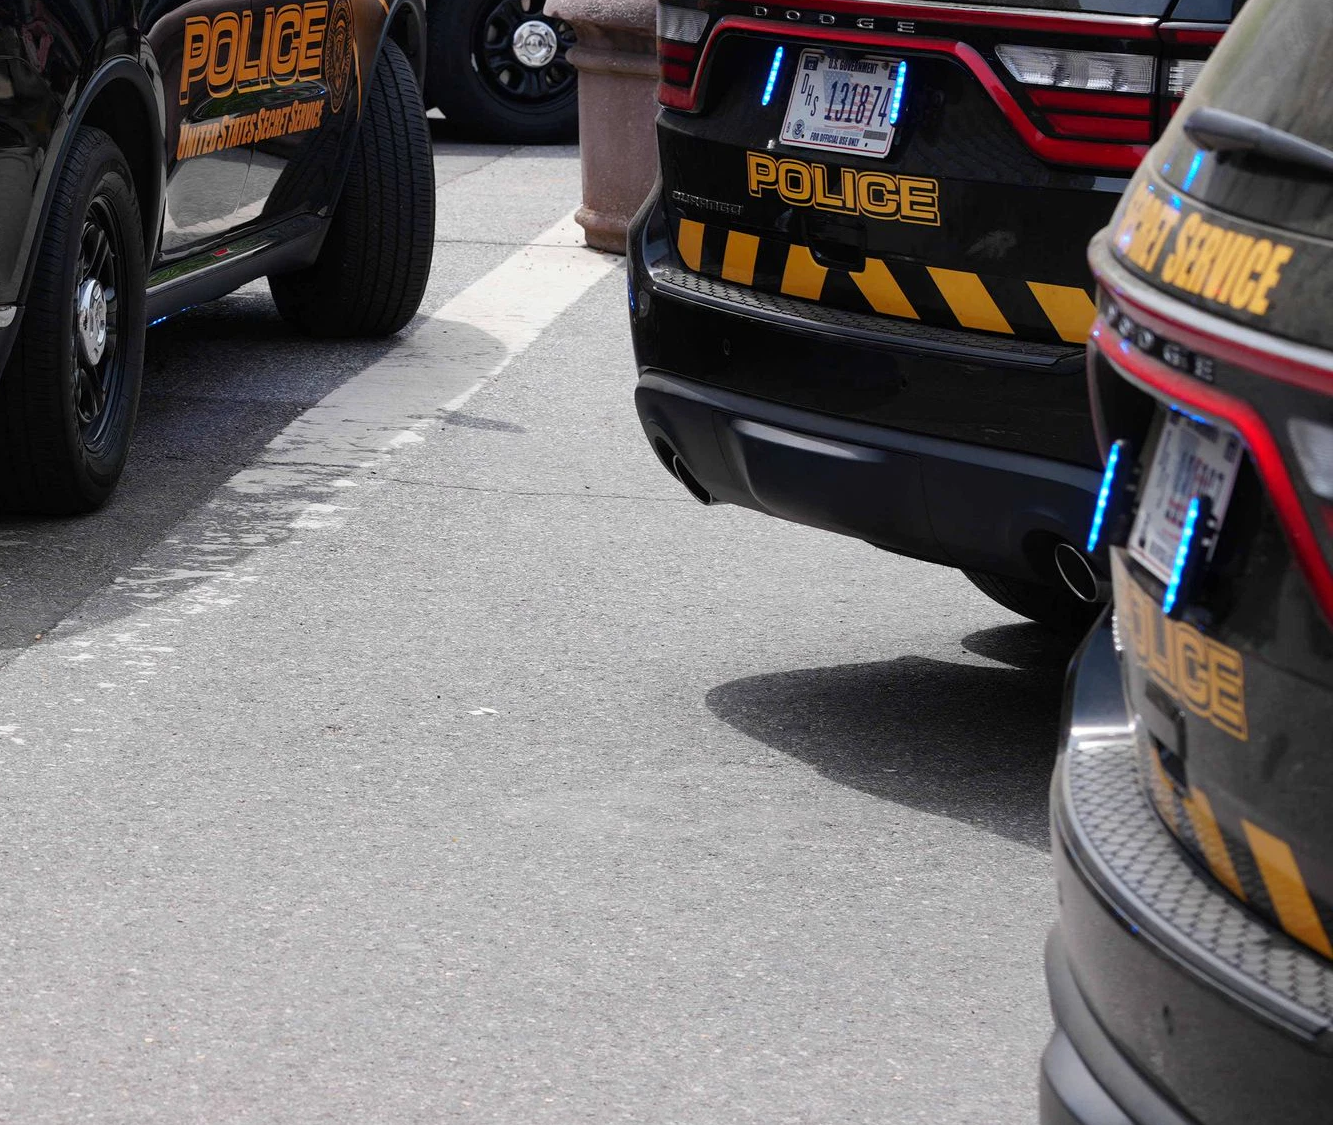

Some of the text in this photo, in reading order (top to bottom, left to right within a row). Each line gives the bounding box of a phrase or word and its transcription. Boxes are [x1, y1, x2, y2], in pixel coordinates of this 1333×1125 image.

[755, 6, 915, 34] DODGE
[179, 1, 328, 105] POLICE
[839, 59, 879, 75] GOVERNMENT
[176, 99, 325, 161] UNITED STATES SECRET SERVICE
[801, 73, 892, 127] DHS 131874
[810, 132, 860, 147] FOR OFFICIAL USE ONLY
[747, 151, 940, 226] POLICE
[1161, 211, 1294, 316] SERVICE
[1123, 577, 1249, 743] OLICE
